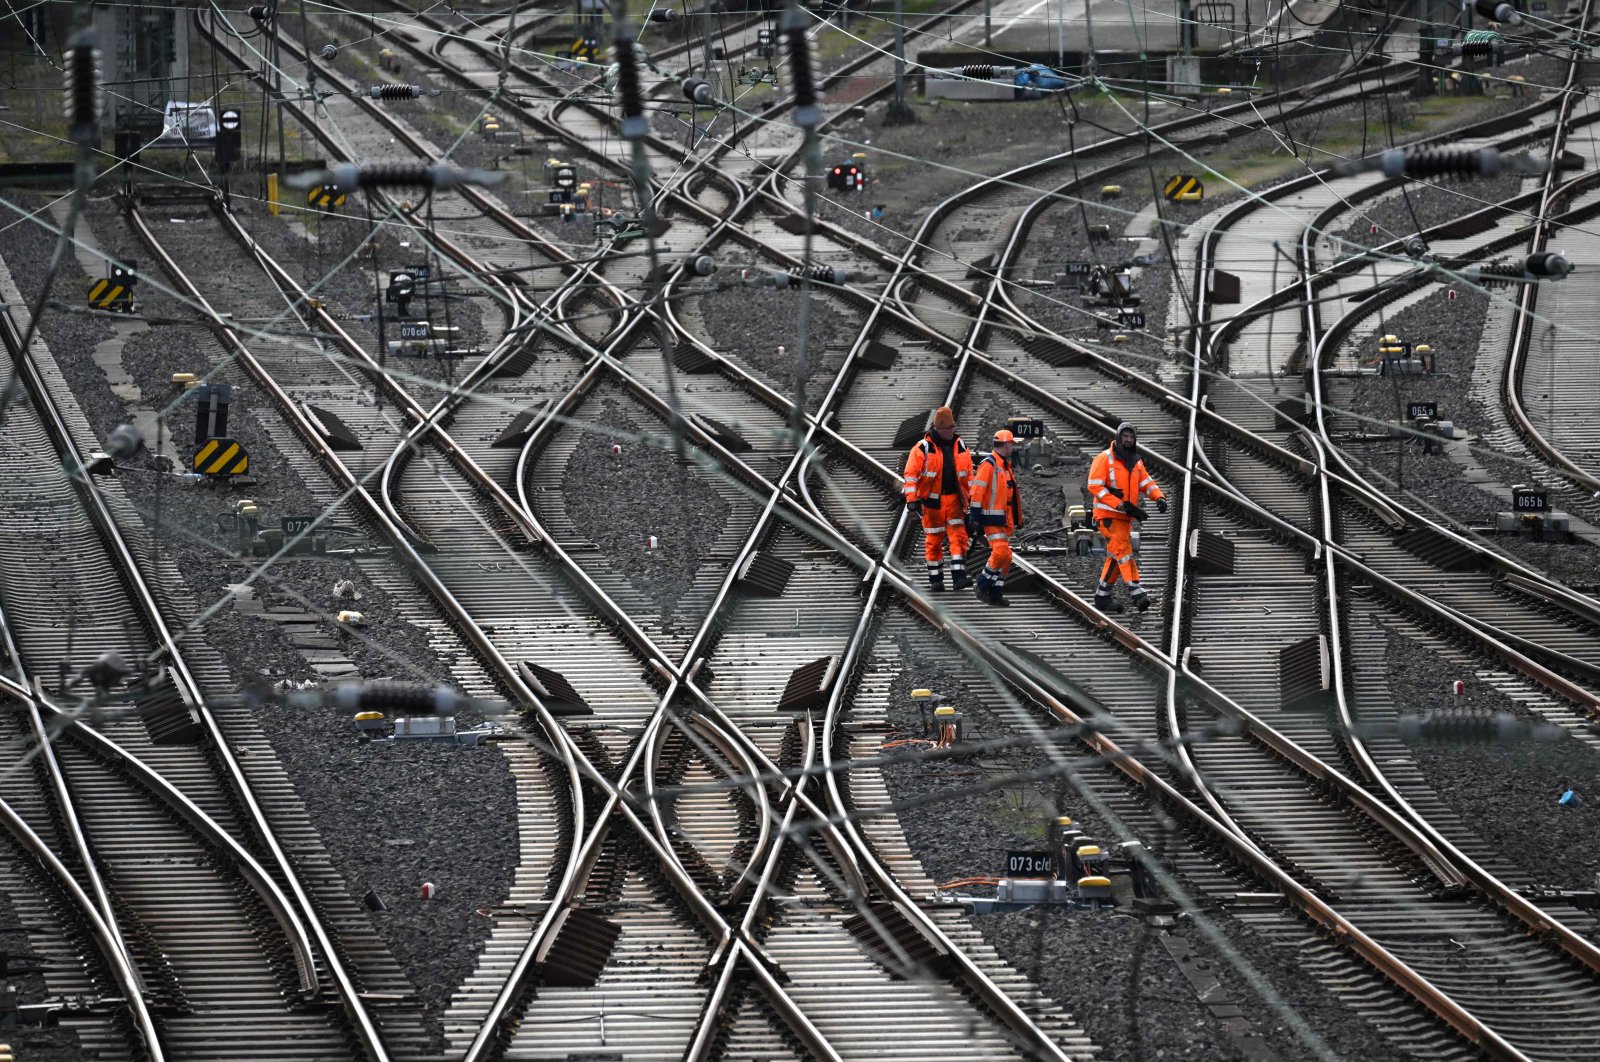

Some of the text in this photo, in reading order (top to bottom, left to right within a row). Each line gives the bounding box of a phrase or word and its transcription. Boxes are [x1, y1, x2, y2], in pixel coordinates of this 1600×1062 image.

[1137, 315, 1142, 325] b
[402, 327, 427, 337] 070 c/d
[1412, 406, 1434, 416] 065 a
[1017, 424, 1040, 434] 071 a
[1518, 496, 1543, 507] 065 b
[287, 521, 310, 532] 072
[1010, 856, 1052, 872] 073 c/d
